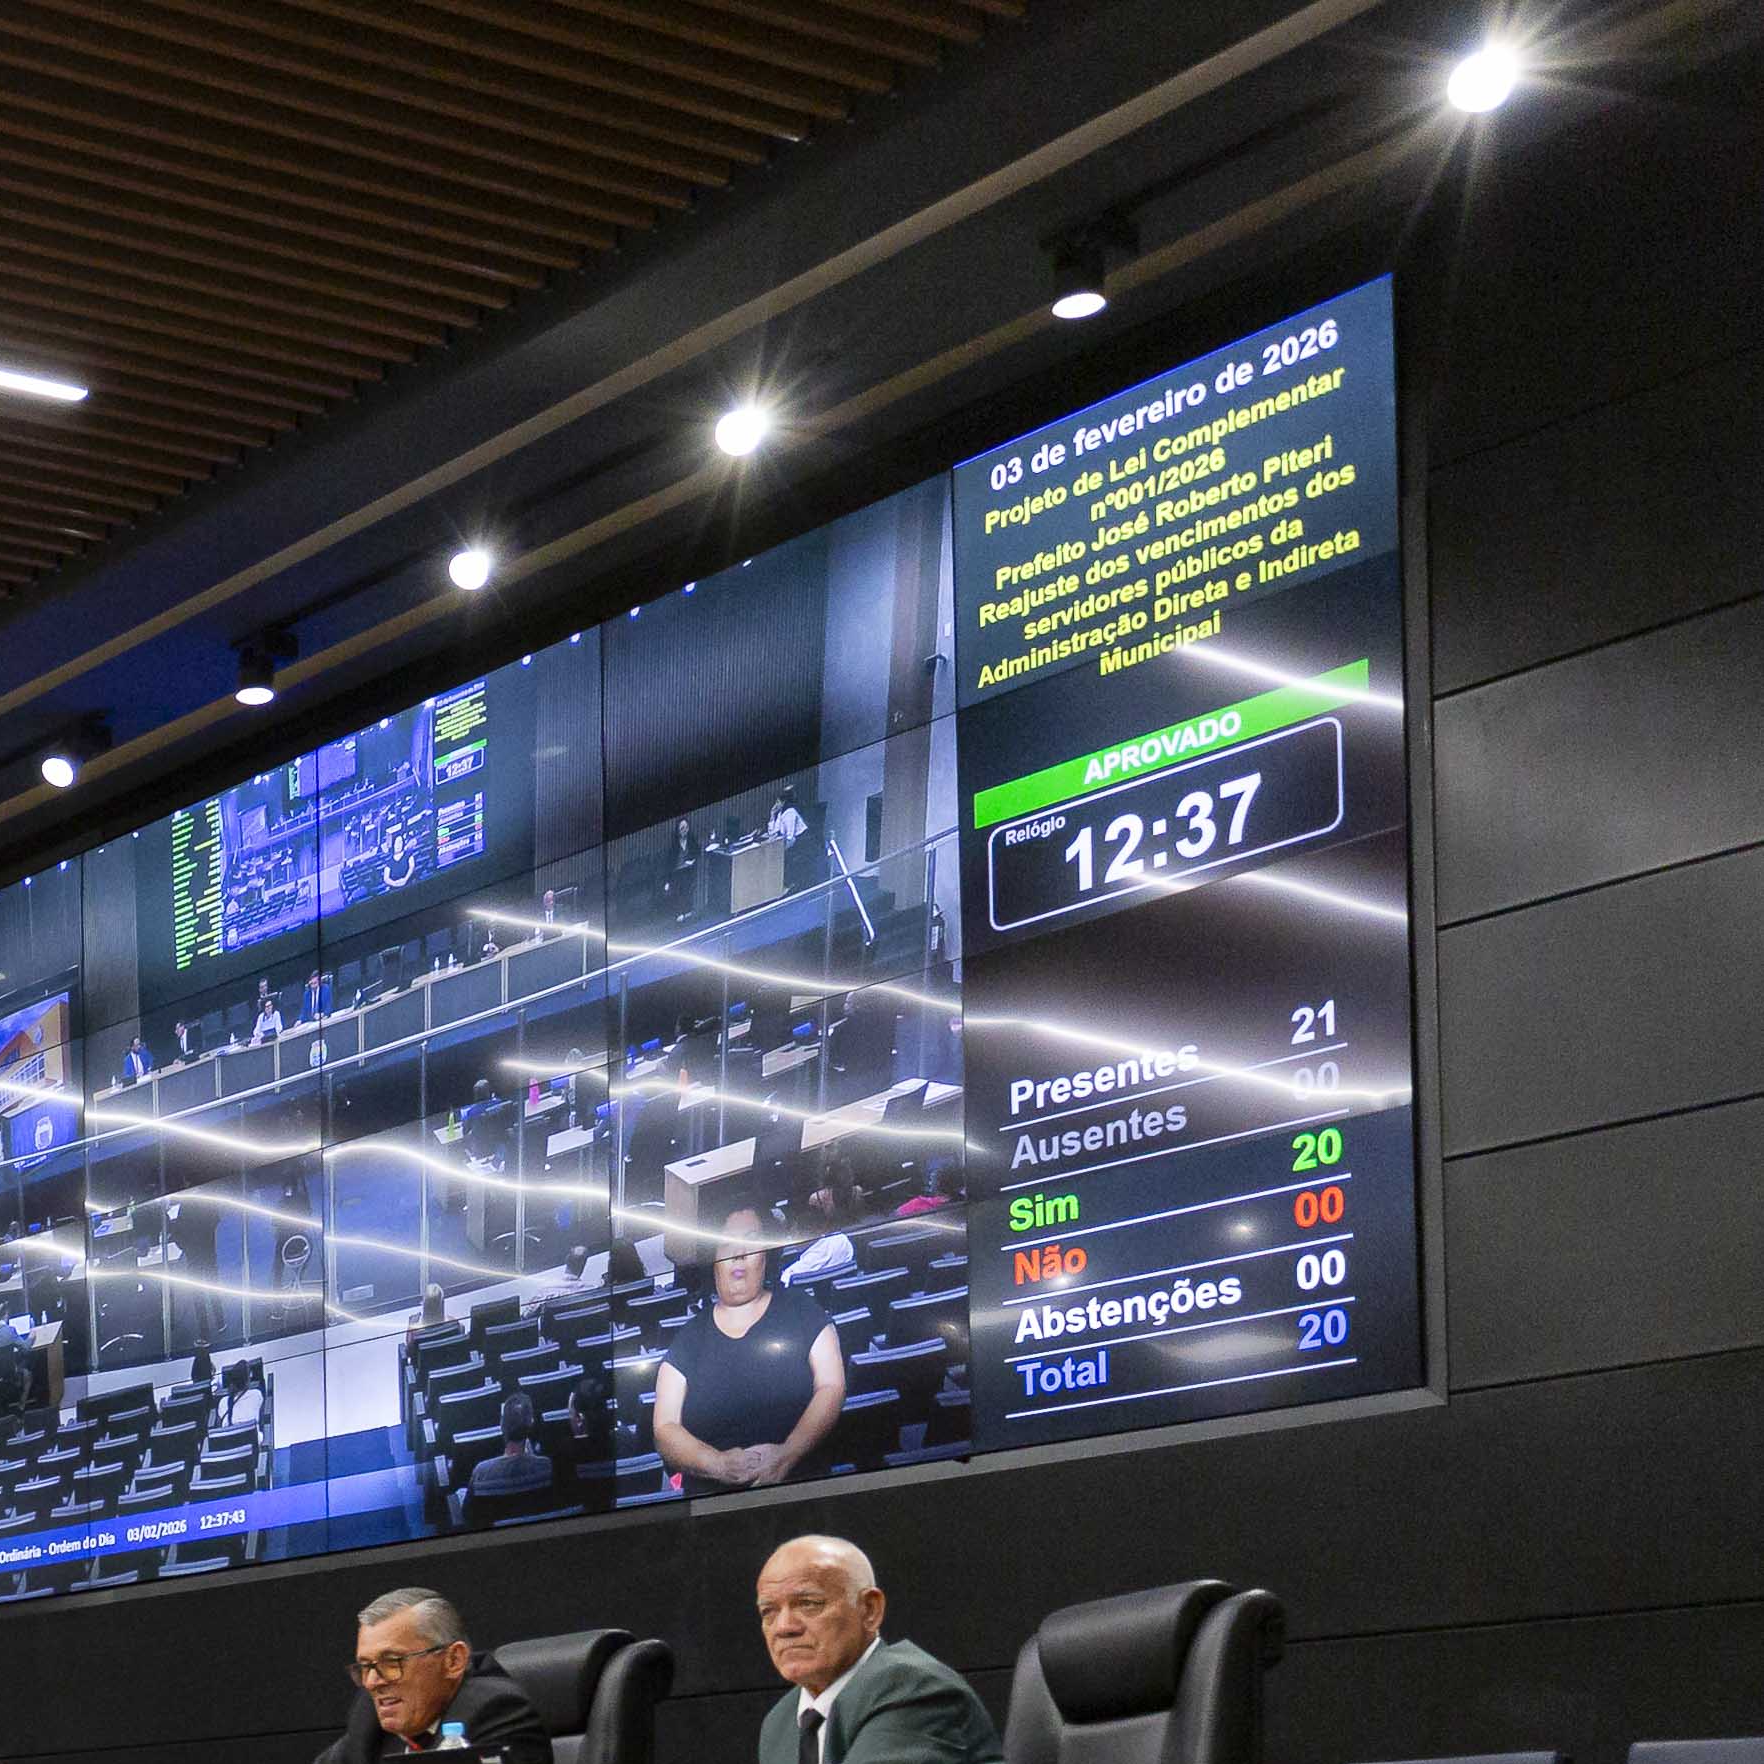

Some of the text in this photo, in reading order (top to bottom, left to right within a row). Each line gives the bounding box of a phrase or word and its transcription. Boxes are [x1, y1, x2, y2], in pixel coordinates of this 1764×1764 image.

[984, 366, 1344, 534] Projeto de Lei Complementar
[990, 319, 1339, 490] 03 de fevereiro de 2026
[995, 435, 1332, 590] Prefeito José Roberto Piteri
[1090, 448, 1226, 521] nº001/2026
[979, 463, 1355, 628] Reajuste dos vencimentos dos
[1023, 517, 1303, 641] servidores públicos da
[978, 529, 1360, 689] Administração Direta e Indireta
[1084, 712, 1241, 785] APROVADO
[1005, 815, 1066, 845] Relógio
[1065, 773, 1261, 892] 12:37
[1009, 1000, 1336, 1115] Presentes 21
[1010, 1062, 1340, 1170] Ausentes 00
[1009, 1128, 1343, 1231] Sim 20
[1014, 1187, 1345, 1286] Não 00
[1014, 1250, 1346, 1343] Abstenções 00
[1016, 1309, 1348, 1397] Total 20
[49, 1540, 81, 1556] Ordem
[83, 1535, 97, 1549] do
[98, 1532, 115, 1547] Dia
[127, 1519, 187, 1543] 03/02/2026
[200, 1509, 246, 1530] 12:37:43
